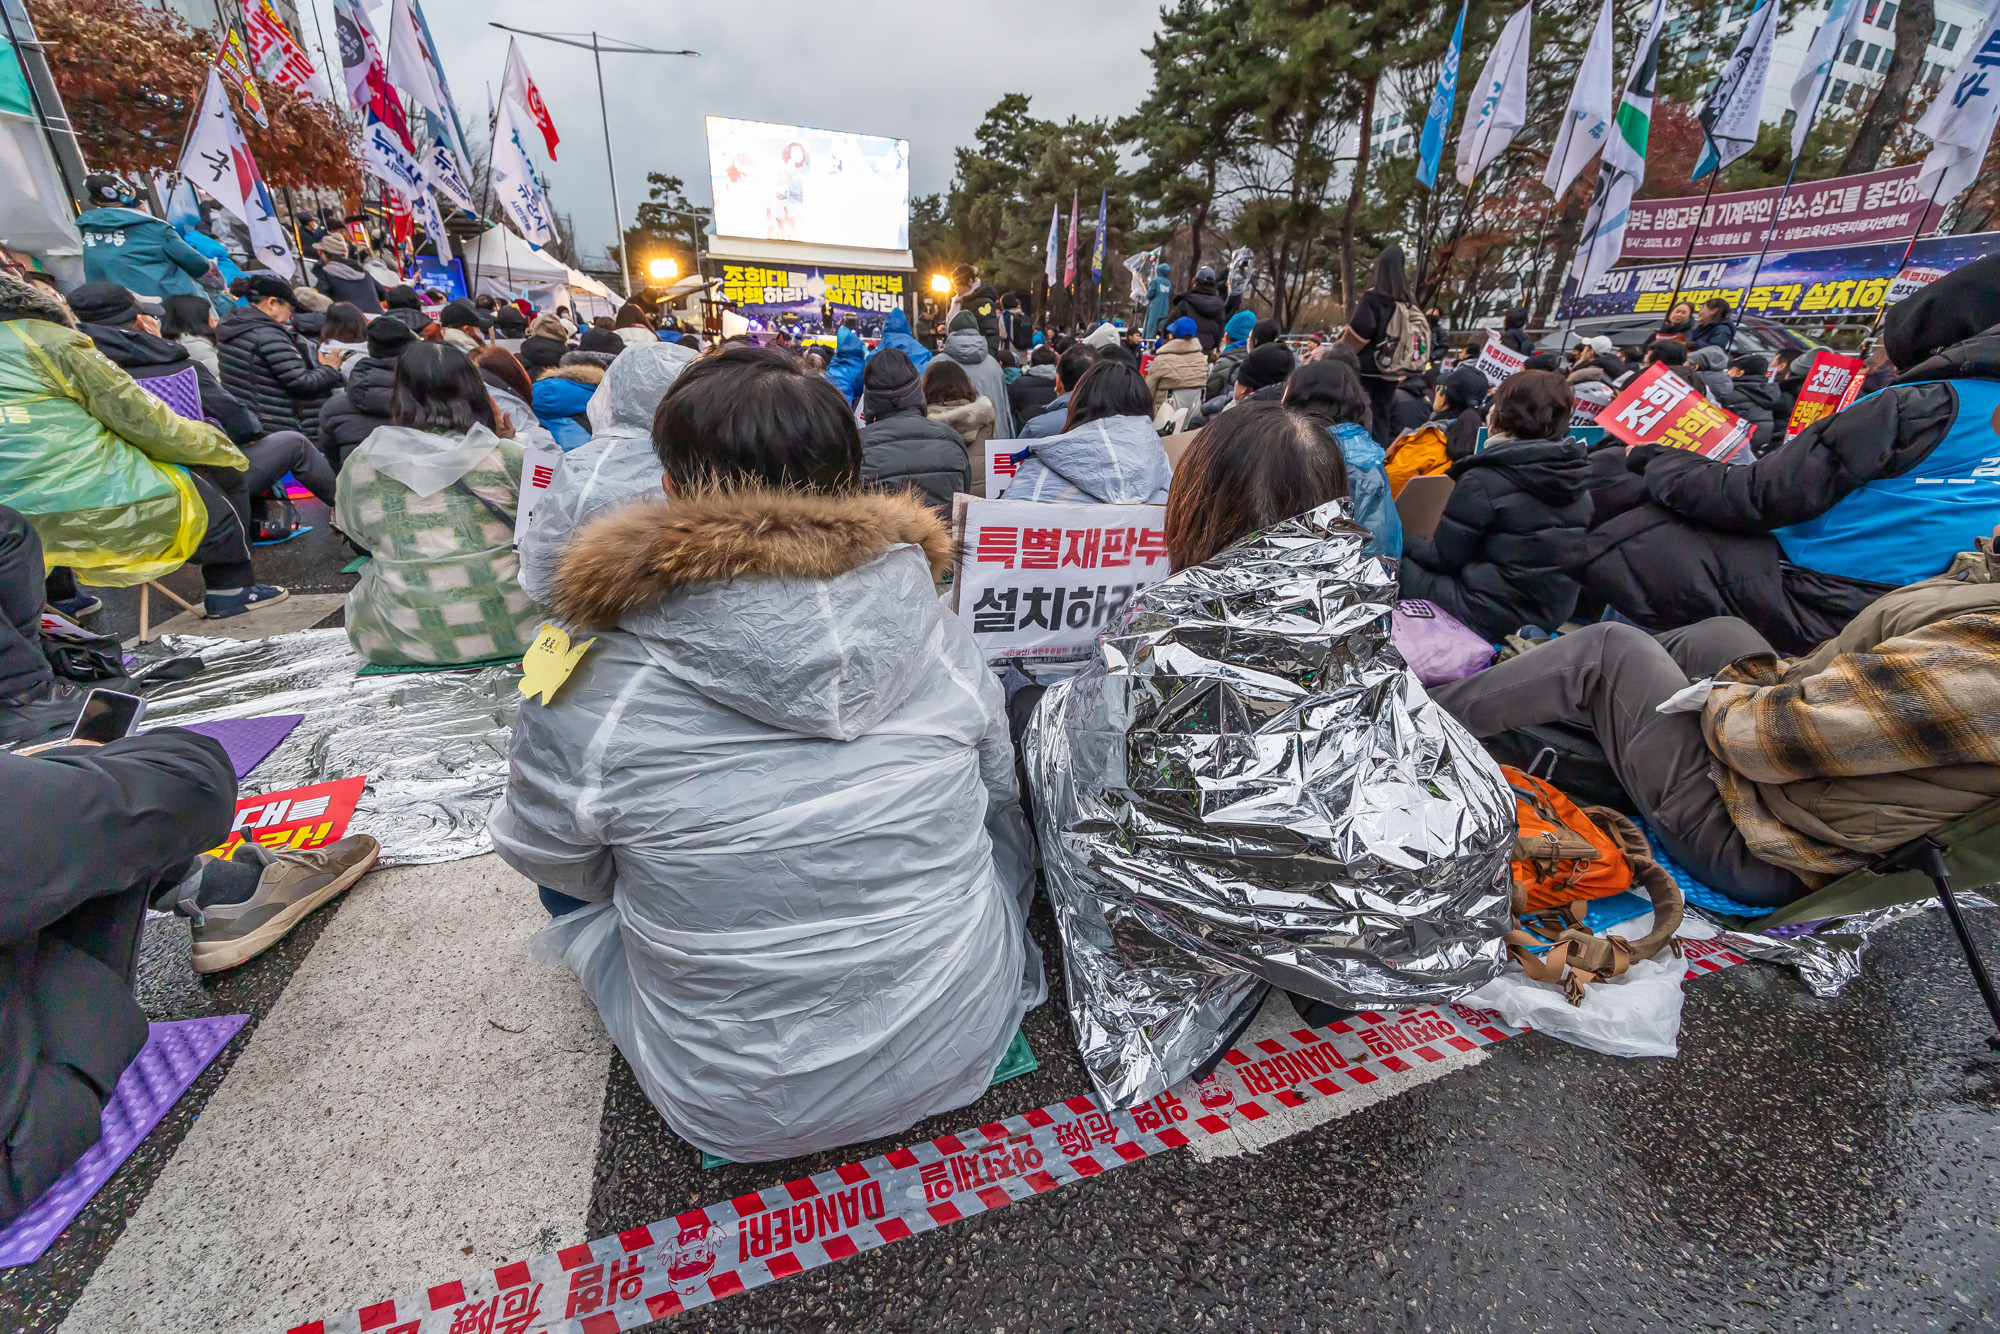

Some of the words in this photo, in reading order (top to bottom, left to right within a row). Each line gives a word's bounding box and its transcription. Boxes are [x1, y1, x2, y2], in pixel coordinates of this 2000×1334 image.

[1715, 198, 1774, 226] 기계적인
[1863, 177, 1928, 210] 중단하
[1588, 270, 1634, 295] 판이
[1747, 279, 1802, 312] 즉각
[1799, 277, 1894, 311] 설치하
[1891, 284, 1919, 295] 설치
[1900, 270, 1943, 284] 특별재판
[1657, 398, 1730, 452] 탄핵하
[976, 526, 1168, 570] 특별재판부
[230, 795, 331, 833] 대를
[1235, 1041, 1350, 1097] DANGER!
[919, 1133, 1043, 1203] 안전제일
[738, 1181, 886, 1263] DANGER!
[565, 1254, 645, 1320] 위험
